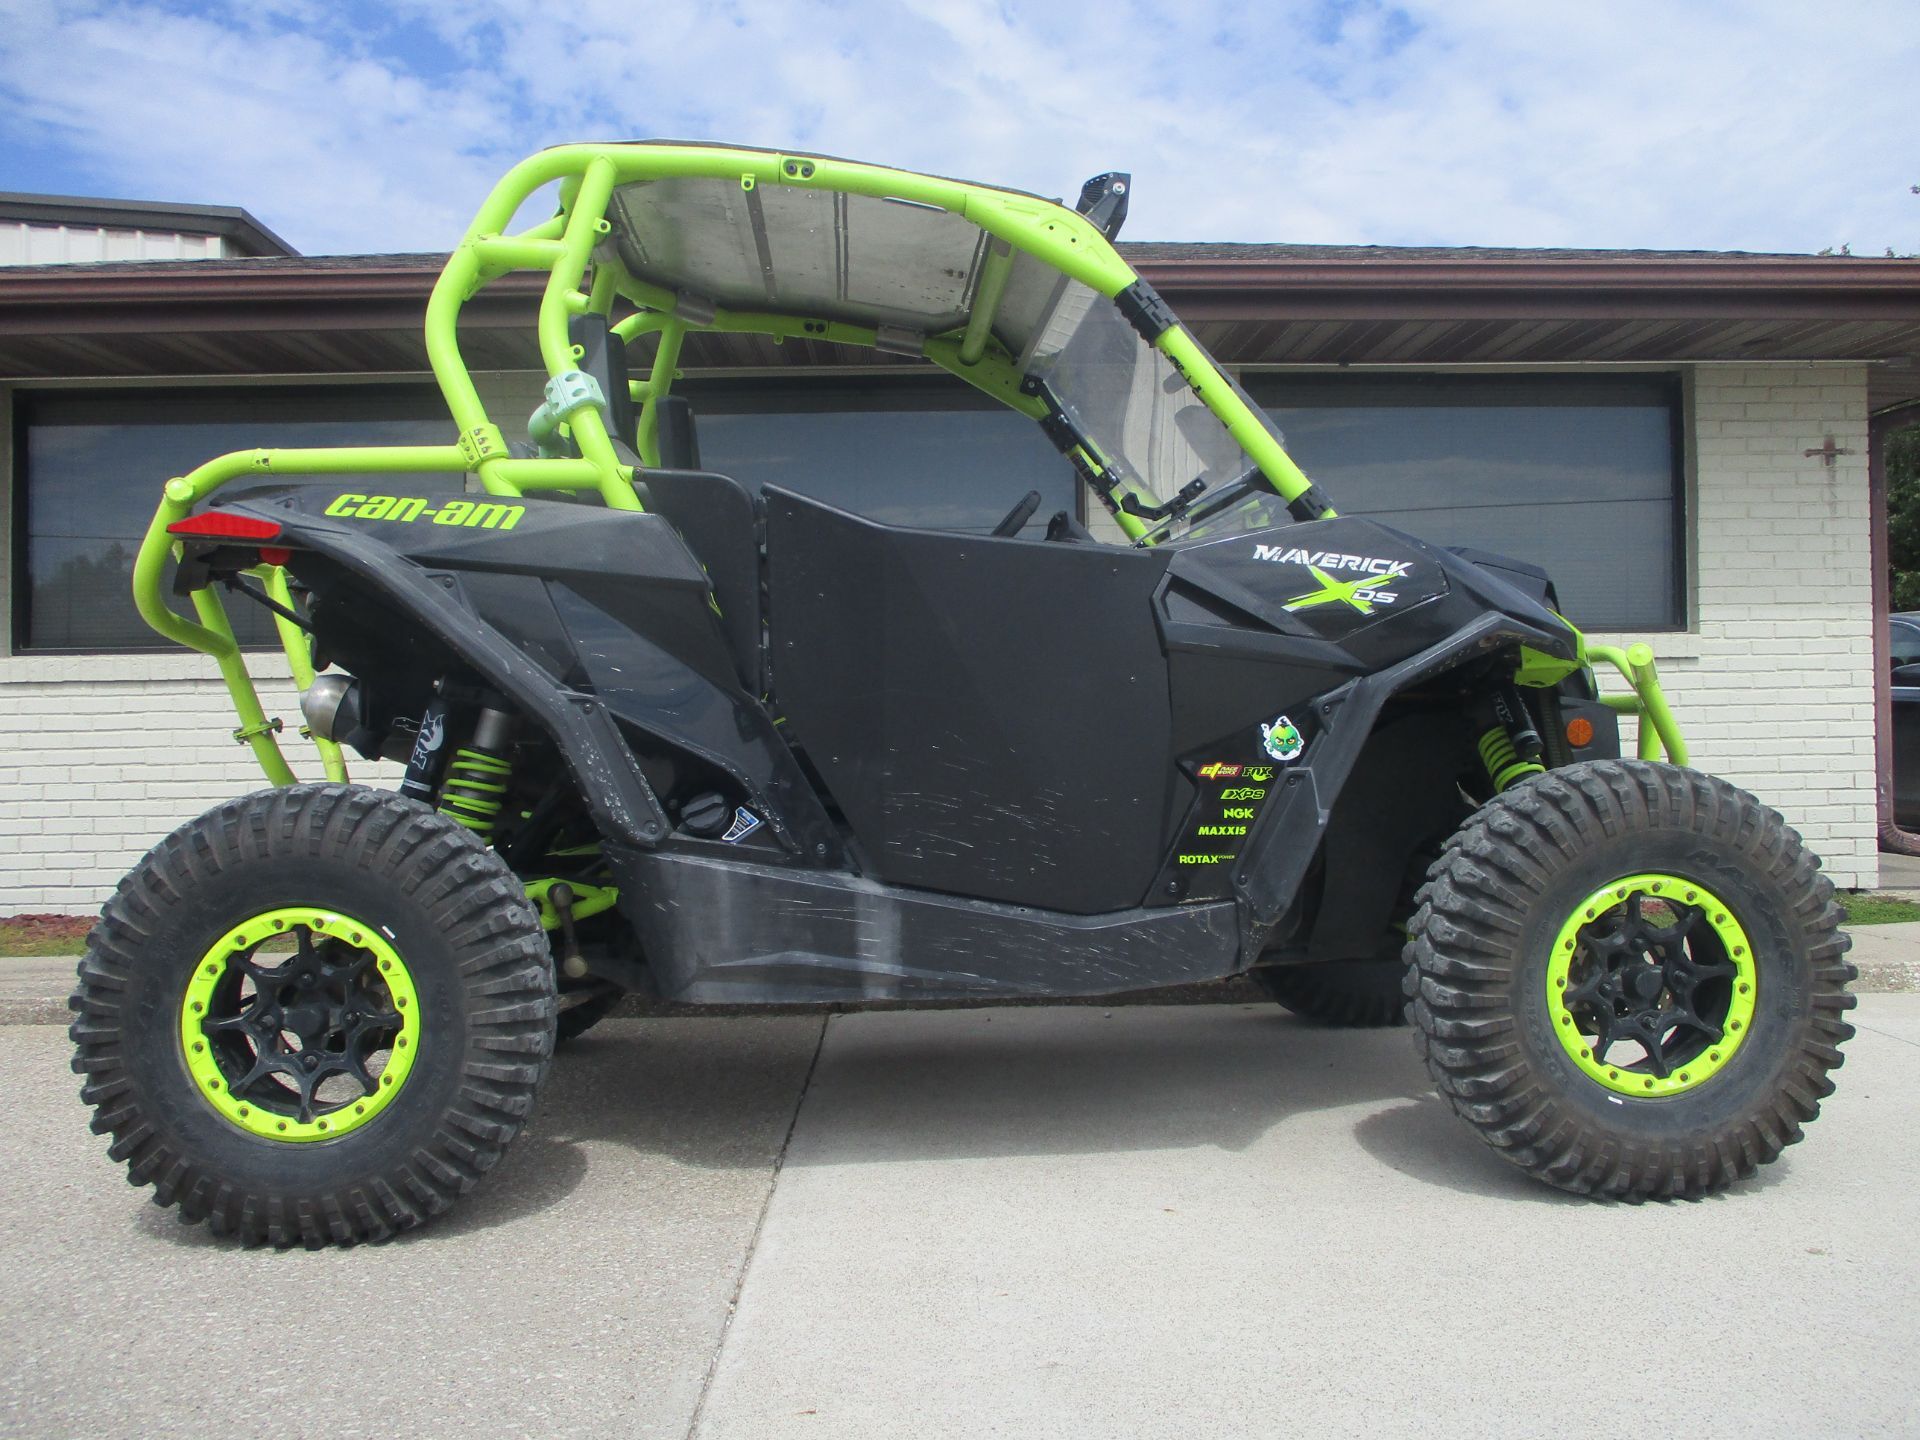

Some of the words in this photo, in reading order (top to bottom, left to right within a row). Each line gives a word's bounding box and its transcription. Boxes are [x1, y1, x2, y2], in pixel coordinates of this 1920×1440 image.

[1252, 544, 1414, 577] MAVERICK
[1351, 588, 1398, 604] DS
[1242, 766, 1273, 781] FOX
[1223, 808, 1254, 819] NGK
[1198, 826, 1247, 836] MAXXIS
[1179, 855, 1219, 864] ROTAX
